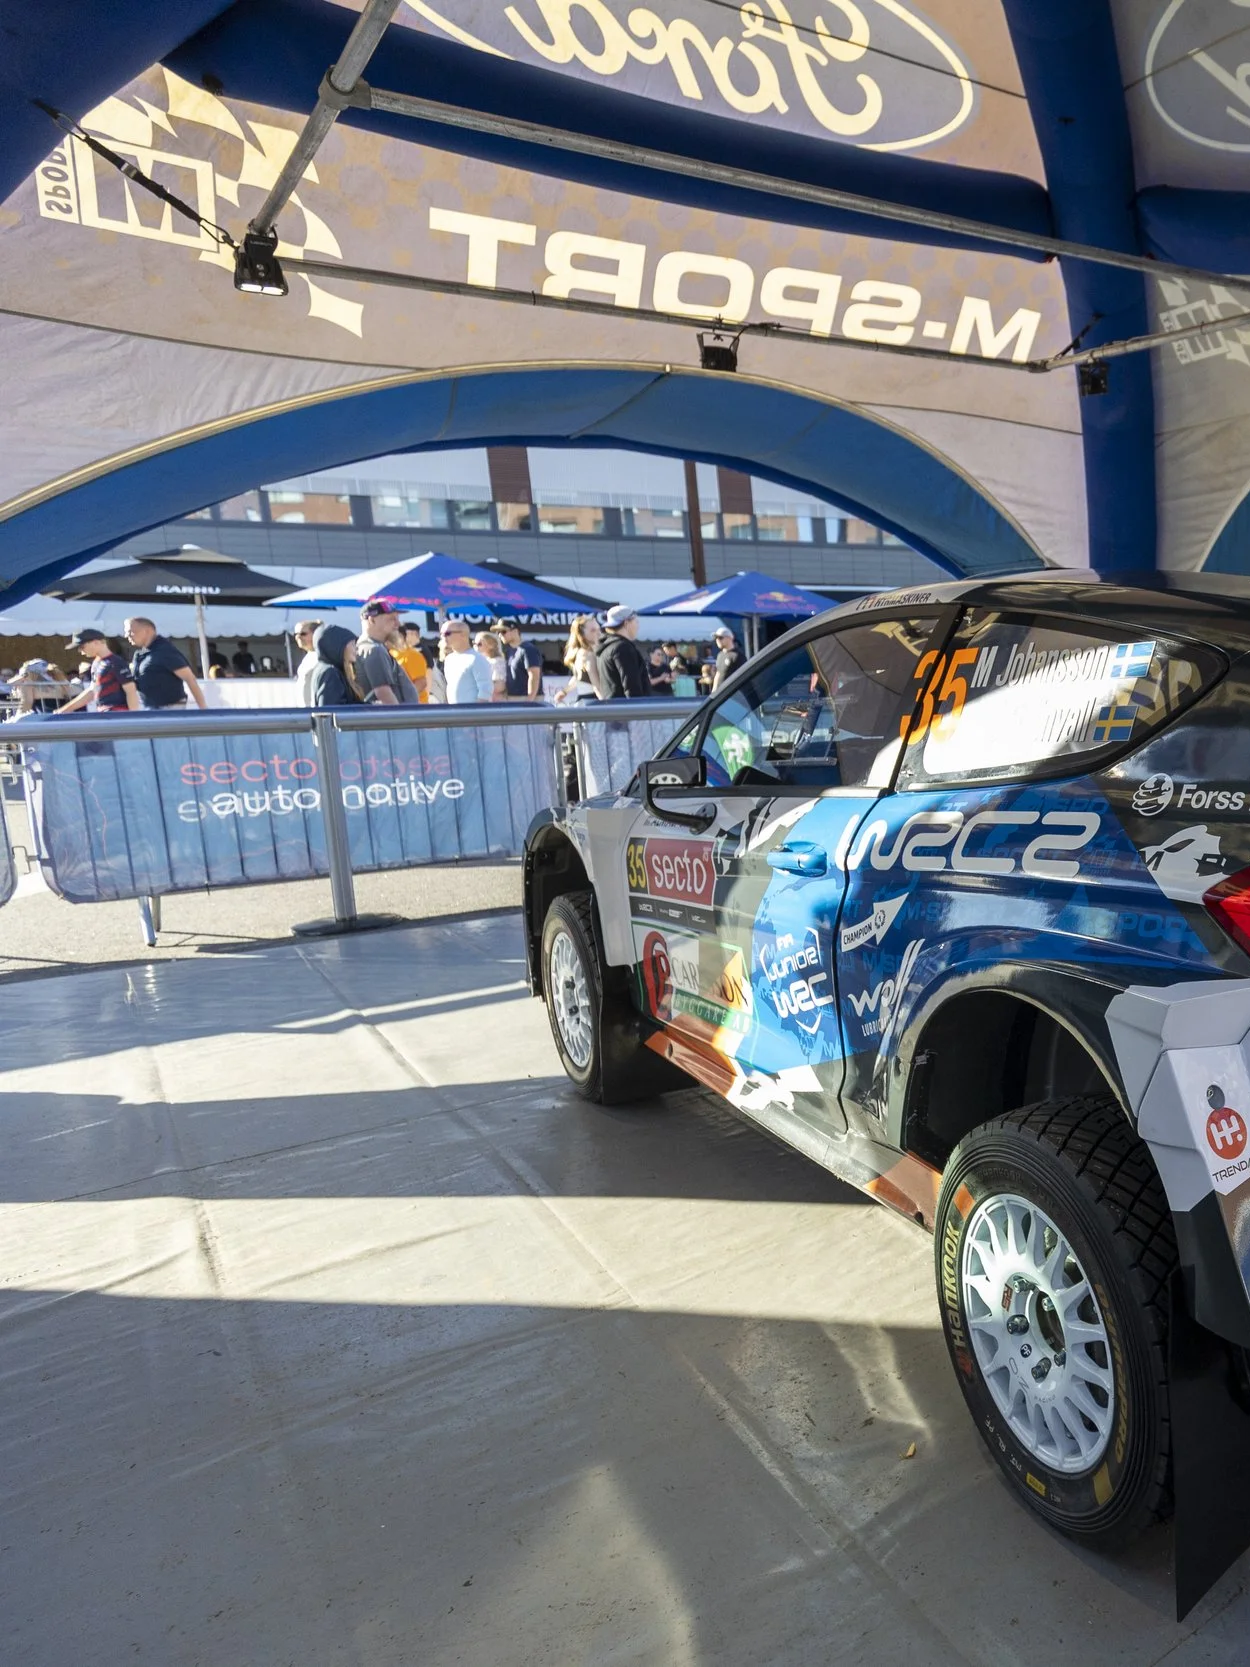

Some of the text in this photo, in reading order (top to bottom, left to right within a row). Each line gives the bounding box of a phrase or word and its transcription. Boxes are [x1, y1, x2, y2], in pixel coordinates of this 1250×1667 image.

[155, 583, 221, 595] KARHU
[970, 641, 1112, 689] M Johansson
[900, 647, 979, 746] 35
[180, 754, 317, 785] secto
[1176, 783, 1246, 811] Forss
[834, 811, 1102, 878] WRC2
[627, 844, 648, 889] 35
[651, 848, 707, 895] secto
[776, 933, 795, 951] FIA
[843, 922, 872, 945] CHAMPION
[768, 946, 819, 982] JUNIOR
[772, 972, 834, 1019] WRC
